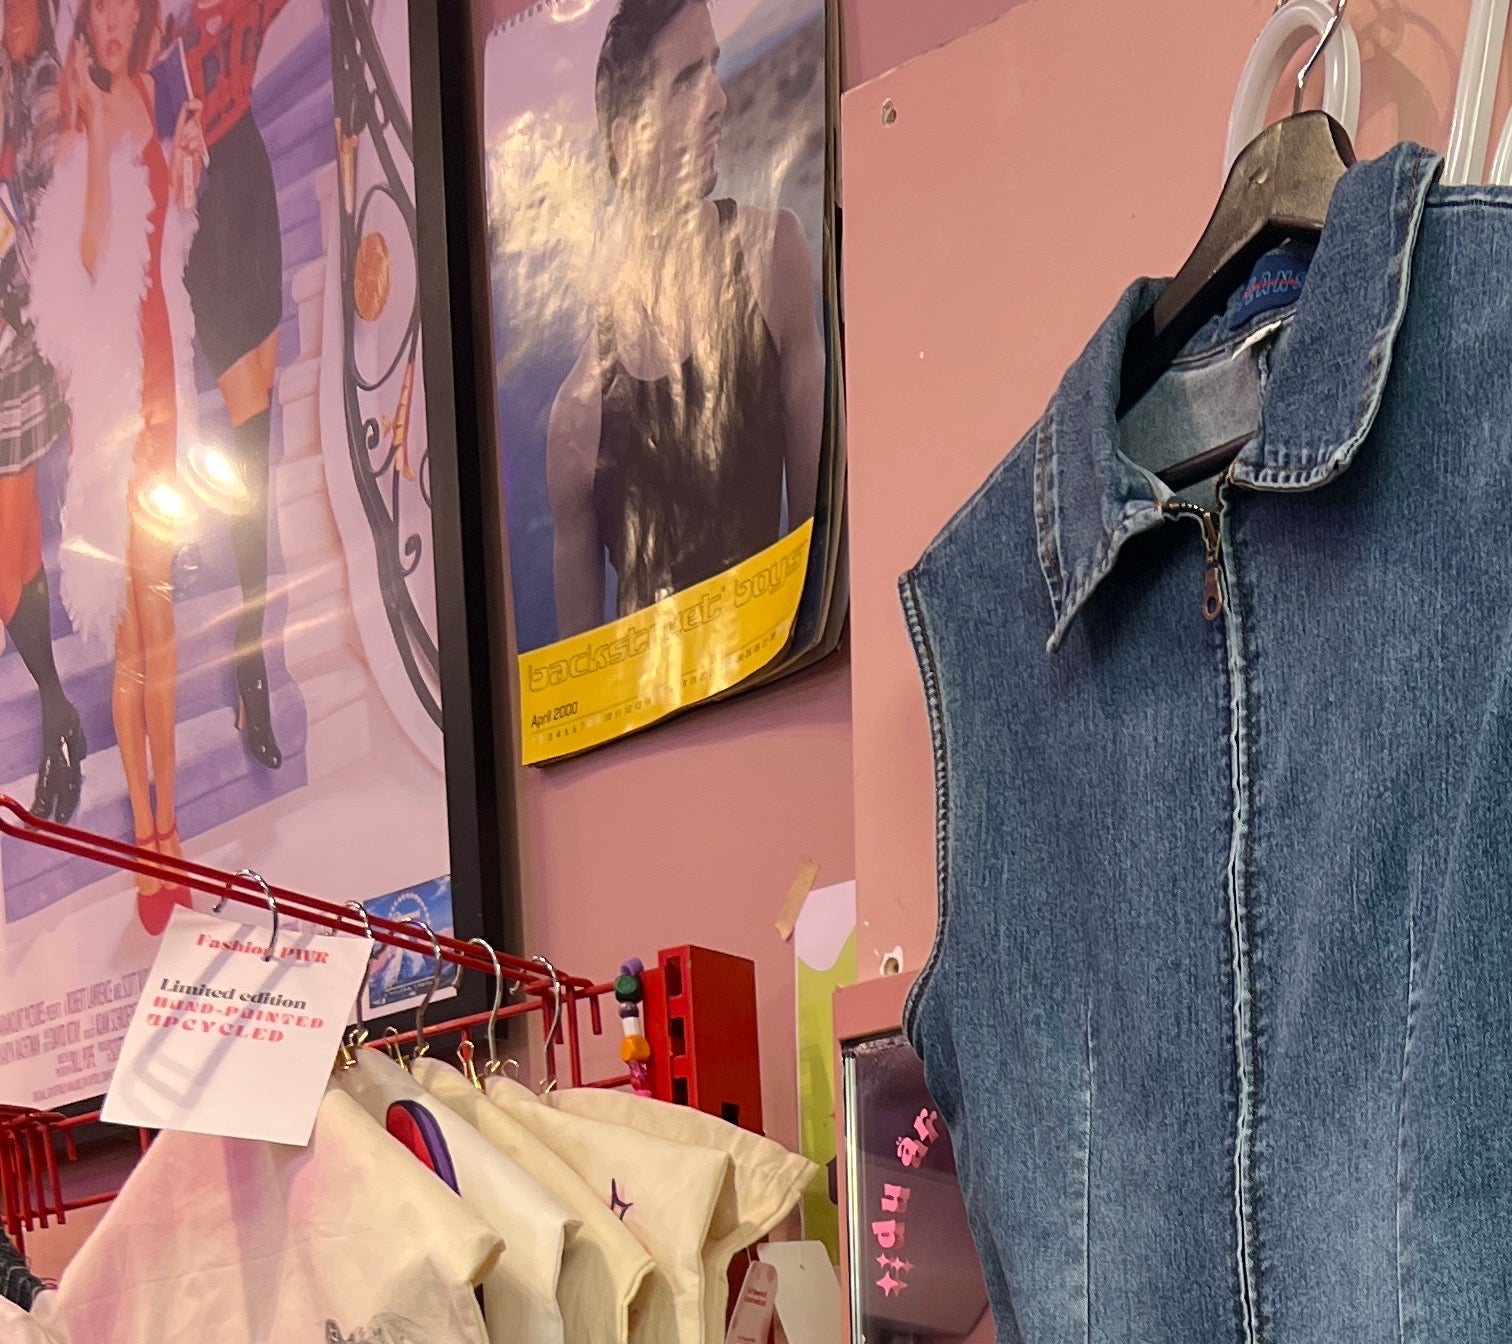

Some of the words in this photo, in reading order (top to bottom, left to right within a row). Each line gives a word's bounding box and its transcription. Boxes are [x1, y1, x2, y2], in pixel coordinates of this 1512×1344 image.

[280, 945, 330, 965] PWR
[160, 977, 236, 1000] Limited
[239, 990, 307, 1010] edition
[146, 1013, 285, 1043] UPCYCLED
